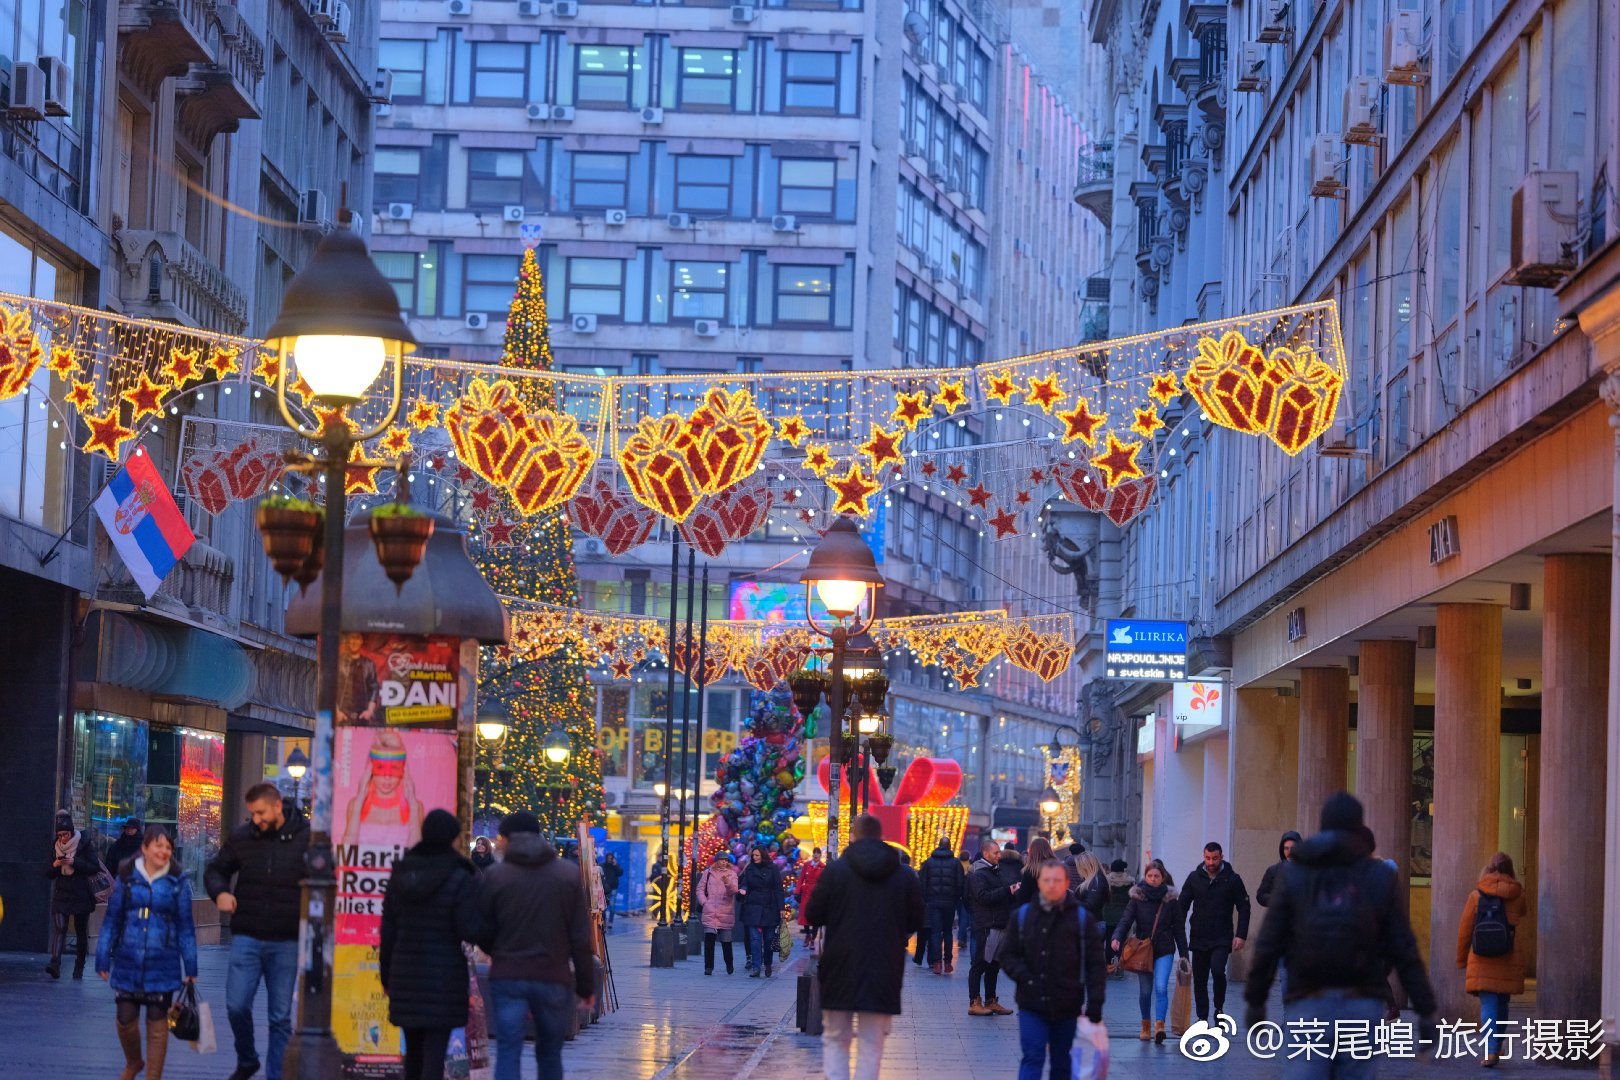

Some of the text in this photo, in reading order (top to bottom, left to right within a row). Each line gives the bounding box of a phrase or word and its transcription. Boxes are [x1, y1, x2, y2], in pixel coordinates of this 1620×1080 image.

[1134, 631, 1185, 642] ILIRIKA
[1107, 653, 1185, 665] NAJPOVOLJNIJE
[1120, 668, 1165, 678] svetskim
[1170, 669, 1184, 679] be
[379, 680, 457, 708] ĐANI
[1176, 713, 1188, 721] vip
[597, 726, 630, 750] OF
[337, 844, 408, 868] Mari
